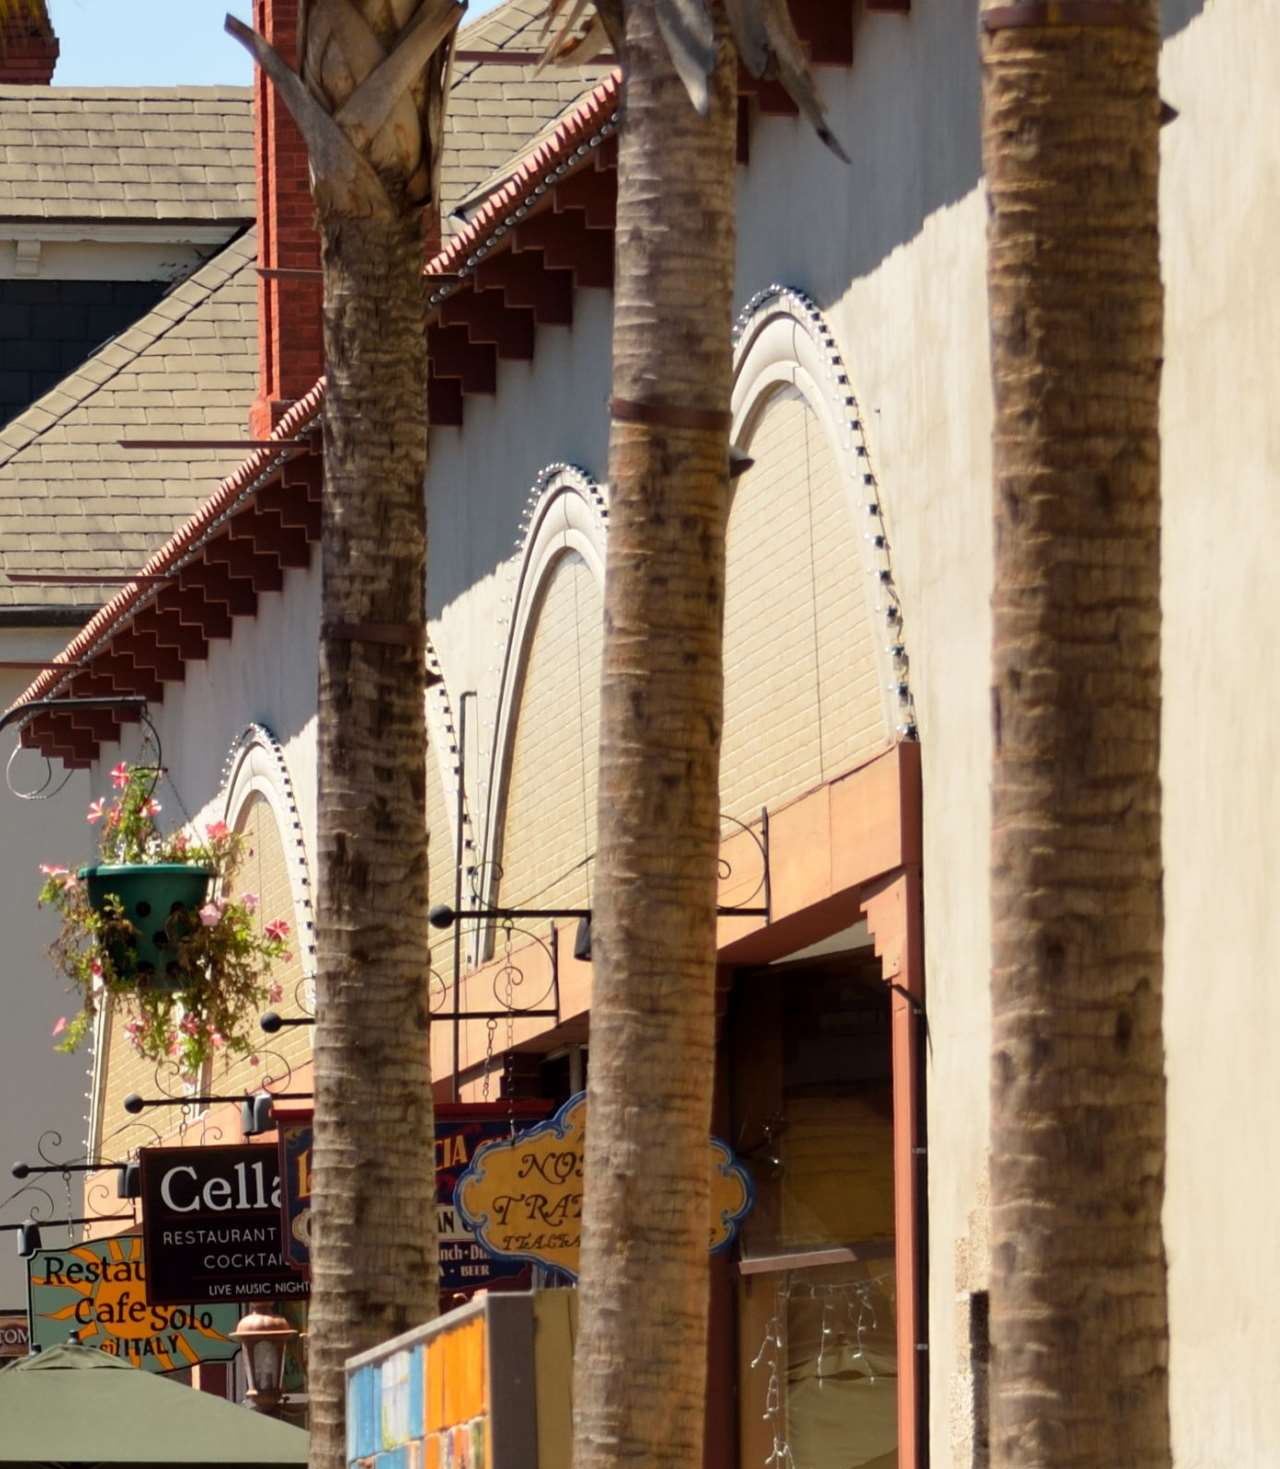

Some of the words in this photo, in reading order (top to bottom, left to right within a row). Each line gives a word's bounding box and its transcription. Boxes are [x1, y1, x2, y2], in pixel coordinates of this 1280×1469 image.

[162, 1227, 278, 1246] RESTAURANT
[203, 1252, 291, 1270] COCKTAI
[208, 1284, 232, 1296] LIVE
[235, 1282, 272, 1295] MUSIC
[74, 1292, 147, 1325] Cafe
